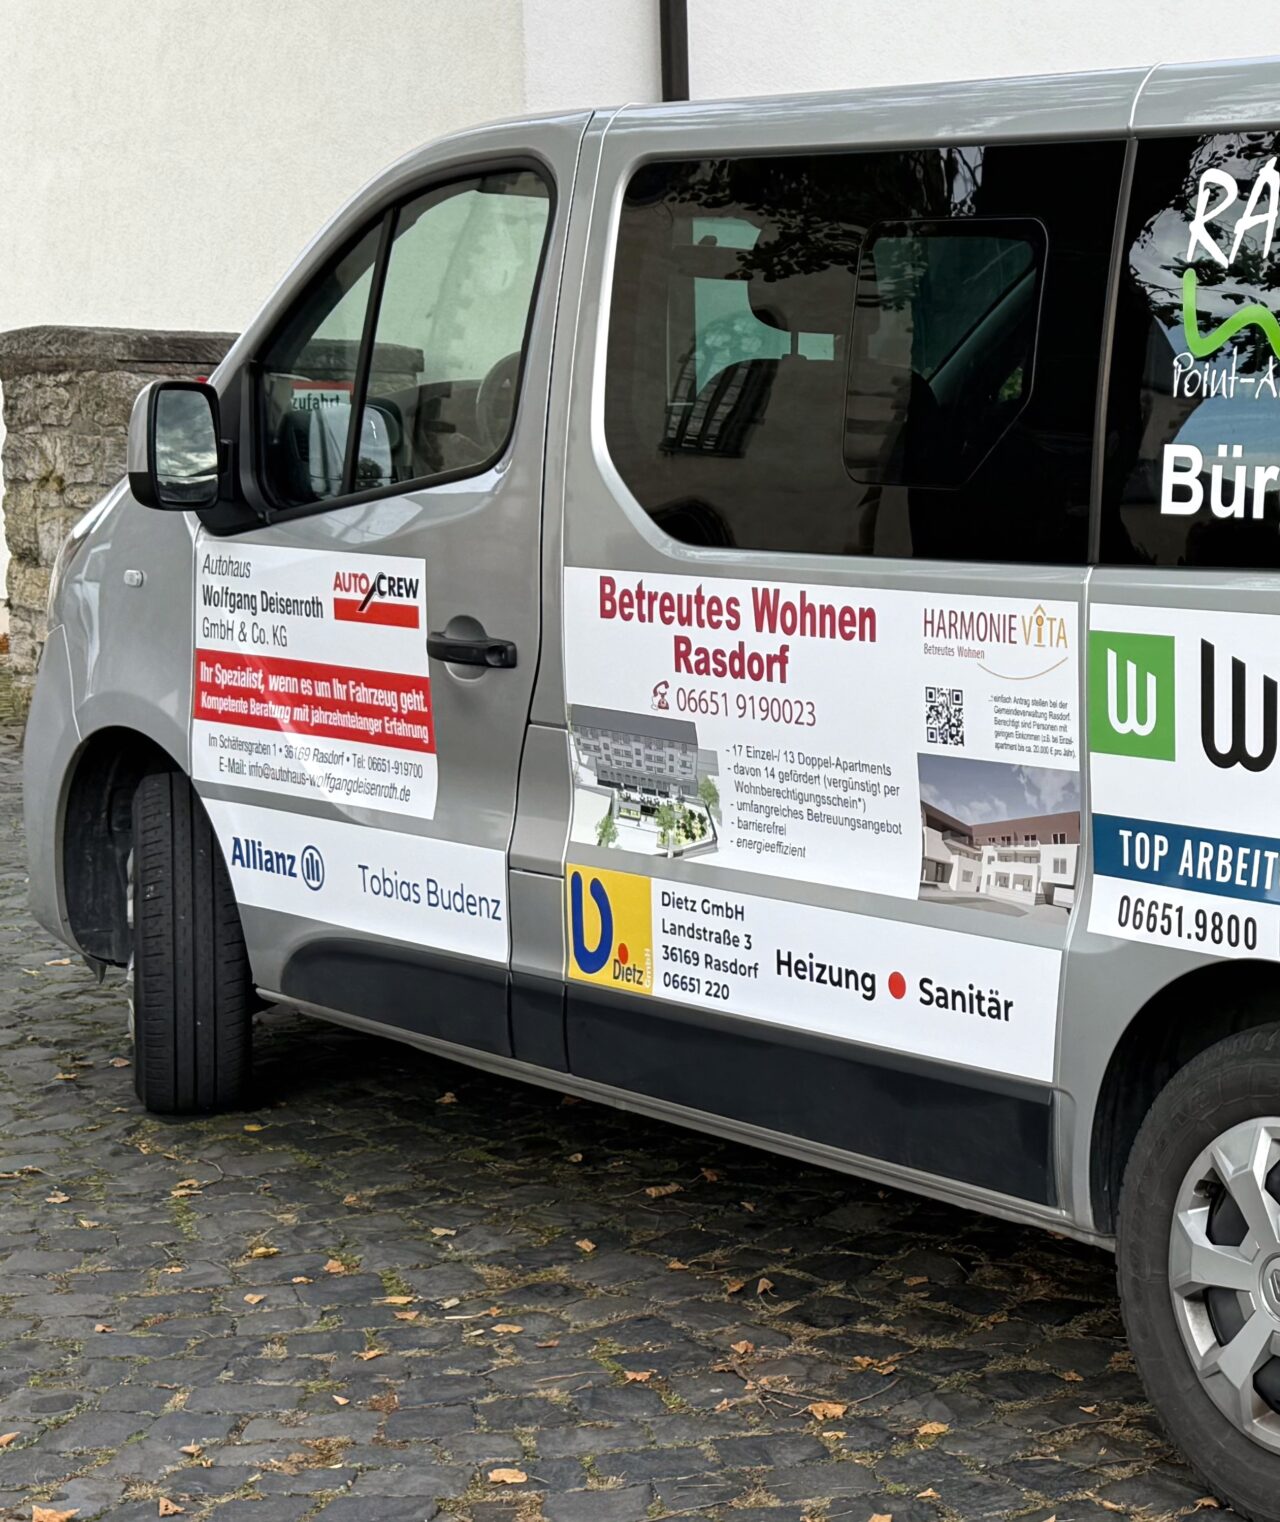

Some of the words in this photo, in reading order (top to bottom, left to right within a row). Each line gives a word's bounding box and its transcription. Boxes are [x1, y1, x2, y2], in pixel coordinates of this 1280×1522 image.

[203, 554, 251, 578] Autohaus
[203, 585, 257, 615] Wolfgang
[261, 590, 323, 619] Deisenroth
[600, 575, 740, 631] Betreutes
[752, 587, 876, 642] Wohnen
[203, 617, 234, 641] GmbH
[238, 623, 247, 642] &
[251, 623, 269, 644] Co.
[273, 626, 287, 646] KG
[924, 608, 1017, 644] HARMONIE
[674, 635, 789, 684] Rasdorf
[924, 643, 954, 656] Betreutes
[958, 646, 984, 659] Wohnen
[201, 661, 212, 682] Ihr
[215, 666, 264, 692] Spezialist,
[269, 675, 298, 693] wenn
[300, 680, 312, 695] es
[315, 682, 330, 697] um
[334, 679, 346, 700] Ihr
[350, 680, 397, 713] Fahrzeug
[401, 689, 427, 714] geht.
[202, 691, 247, 715] Kompetente
[251, 698, 290, 723] Beratung
[293, 705, 309, 722] mit
[311, 706, 382, 736] jahrzehntelanger
[385, 718, 428, 744] Erfahrung
[677, 687, 728, 717] 06651
[737, 694, 816, 727] 9190023
[209, 733, 217, 747] Im
[219, 734, 270, 755] Schäfersgraben
[313, 748, 343, 766] Rasdorf
[368, 758, 423, 778] 06651-919700
[219, 756, 246, 775] E-Mail:
[732, 744, 742, 756] 17
[784, 751, 795, 763] 13
[798, 752, 892, 776] Doppel-Apartments
[734, 763, 761, 778] davon
[764, 767, 775, 778] 14
[779, 770, 820, 785] gefördert
[824, 775, 881, 796] (vergünstigt
[884, 784, 899, 797] per
[737, 801, 804, 820] umfangreiches
[807, 809, 902, 835] Betreuungsangebot
[738, 817, 786, 836] barrierefrei
[231, 837, 297, 878] Allianz
[737, 836, 805, 858] energieeffizient
[1119, 829, 1168, 872] TOP
[358, 864, 421, 904] Tobias
[427, 878, 502, 921] Budenz
[661, 891, 697, 914] Dietz
[702, 898, 745, 921] GmbH
[662, 918, 740, 948] Landstraße
[745, 933, 752, 950] 3
[1118, 895, 1257, 951] 06651.9800
[613, 958, 643, 985] Dietz
[662, 945, 699, 968] 36169
[705, 954, 758, 979] Rasdorf
[663, 973, 701, 995] 06651
[704, 978, 729, 1000] 220
[776, 949, 876, 1001] Heizung
[919, 978, 1013, 1023] Sanitär
